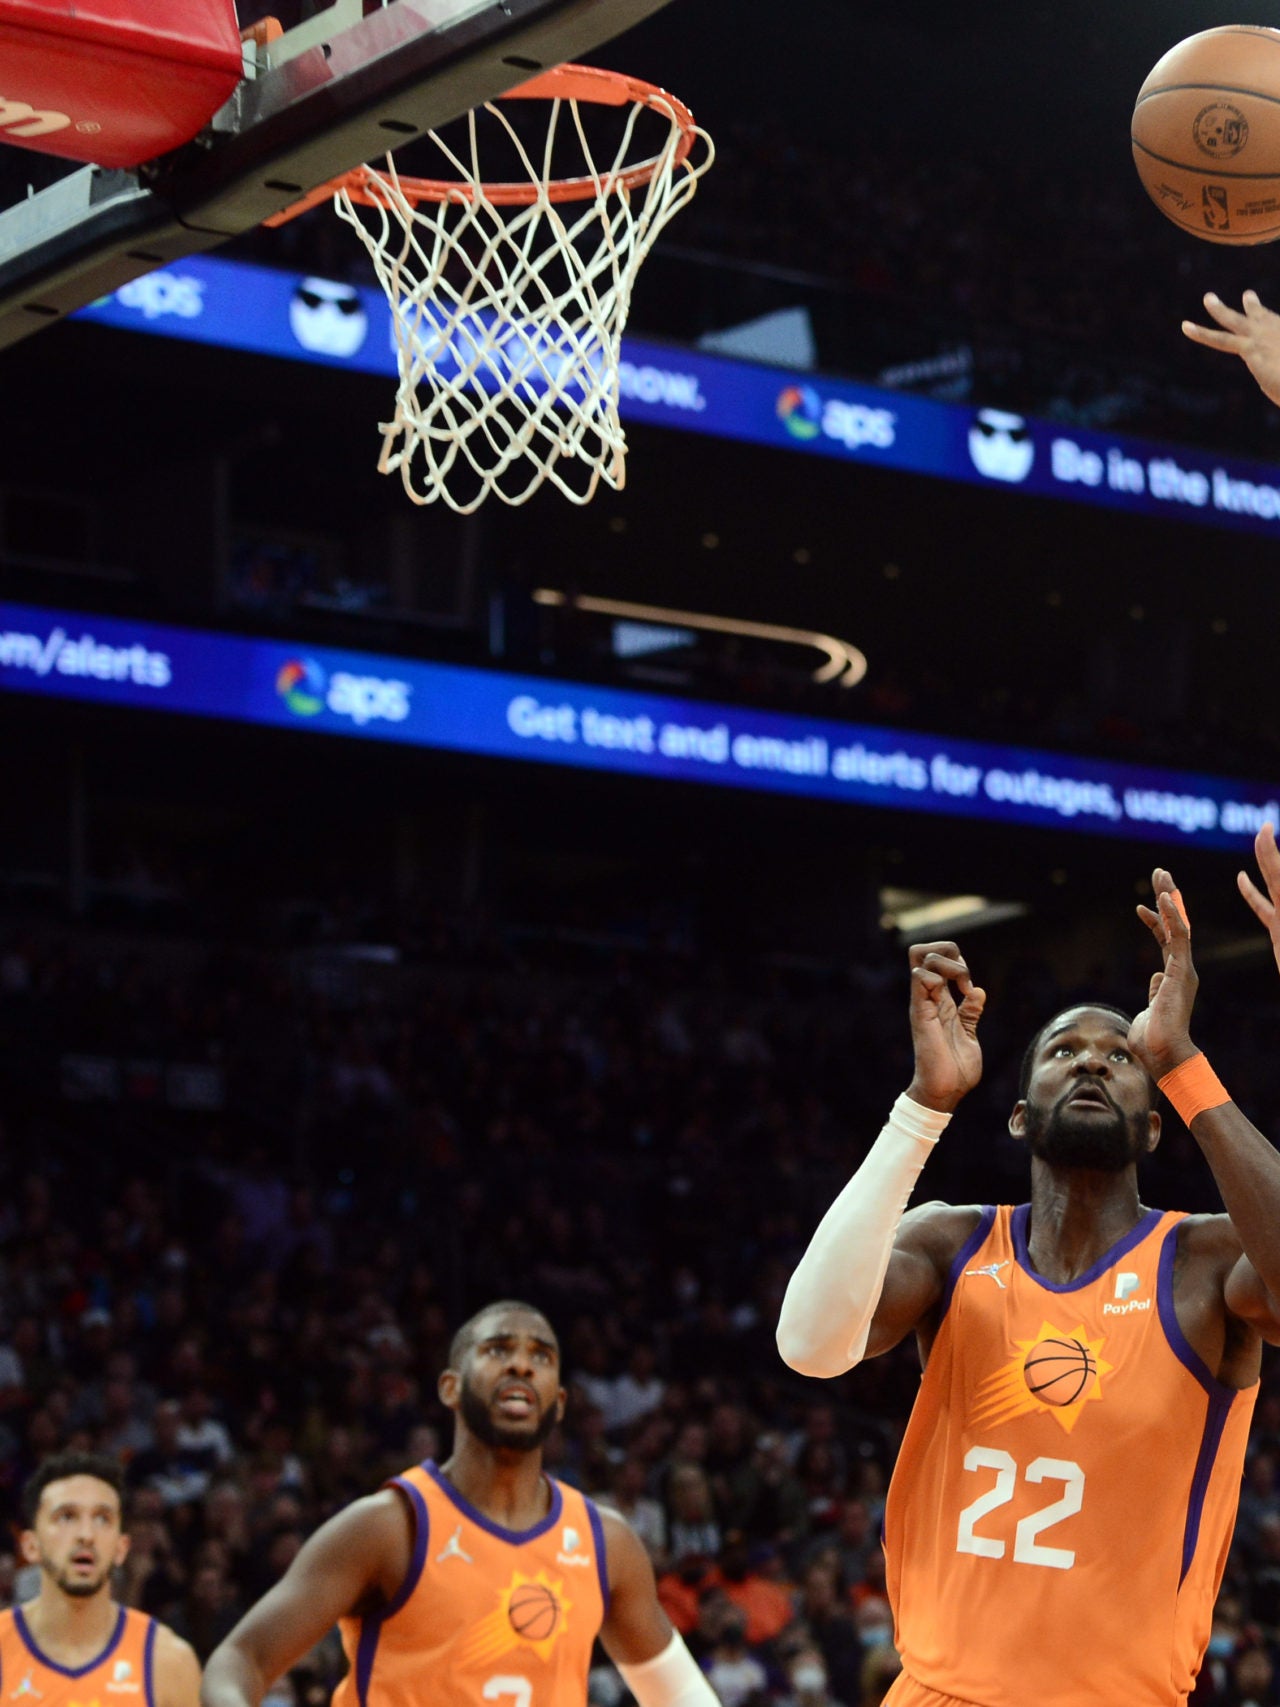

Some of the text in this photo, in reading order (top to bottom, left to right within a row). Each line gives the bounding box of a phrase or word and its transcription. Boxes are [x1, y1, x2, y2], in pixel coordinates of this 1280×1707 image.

[1051, 438, 1103, 486] Be
[1107, 448, 1145, 493] in
[1148, 458, 1209, 506] the
[327, 671, 411, 725] aps
[507, 695, 577, 743] Get
[580, 707, 655, 754] text
[658, 723, 730, 764] and
[731, 734, 829, 777] email
[831, 744, 928, 791] alerts
[930, 753, 981, 796] for
[1124, 787, 1218, 833] usage
[1103, 1298, 1151, 1316] PayPal
[956, 1445, 1085, 1570] 22
